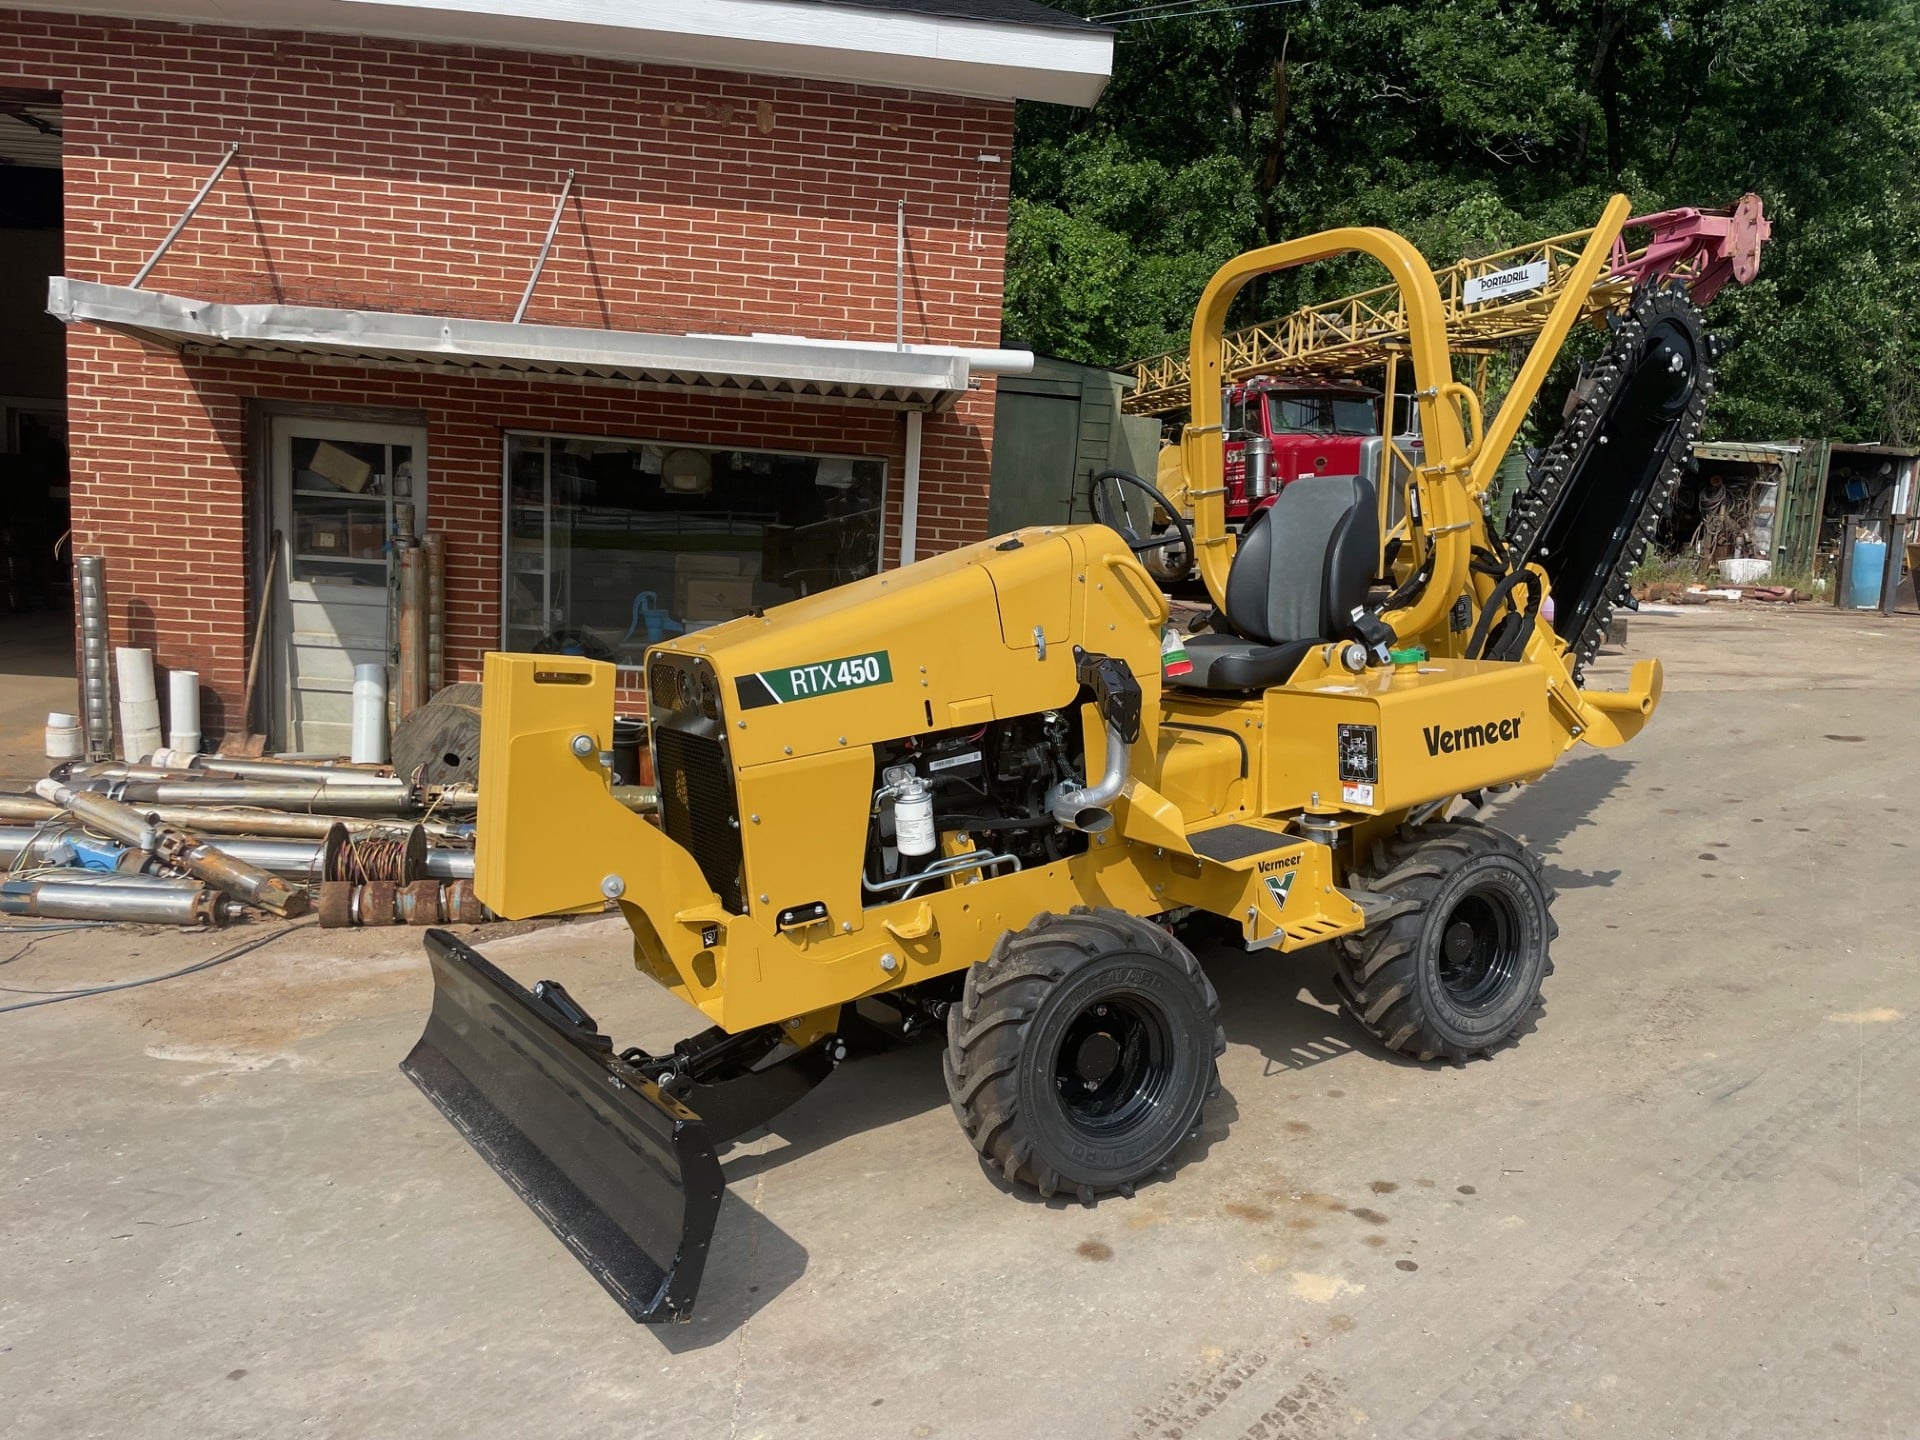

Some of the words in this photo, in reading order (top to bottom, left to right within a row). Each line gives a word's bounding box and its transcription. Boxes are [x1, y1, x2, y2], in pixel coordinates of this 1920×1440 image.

[1480, 270, 1529, 290] PORTADRILL
[1423, 717, 1521, 757] Vermeer
[1258, 855, 1302, 873] Vermeer
